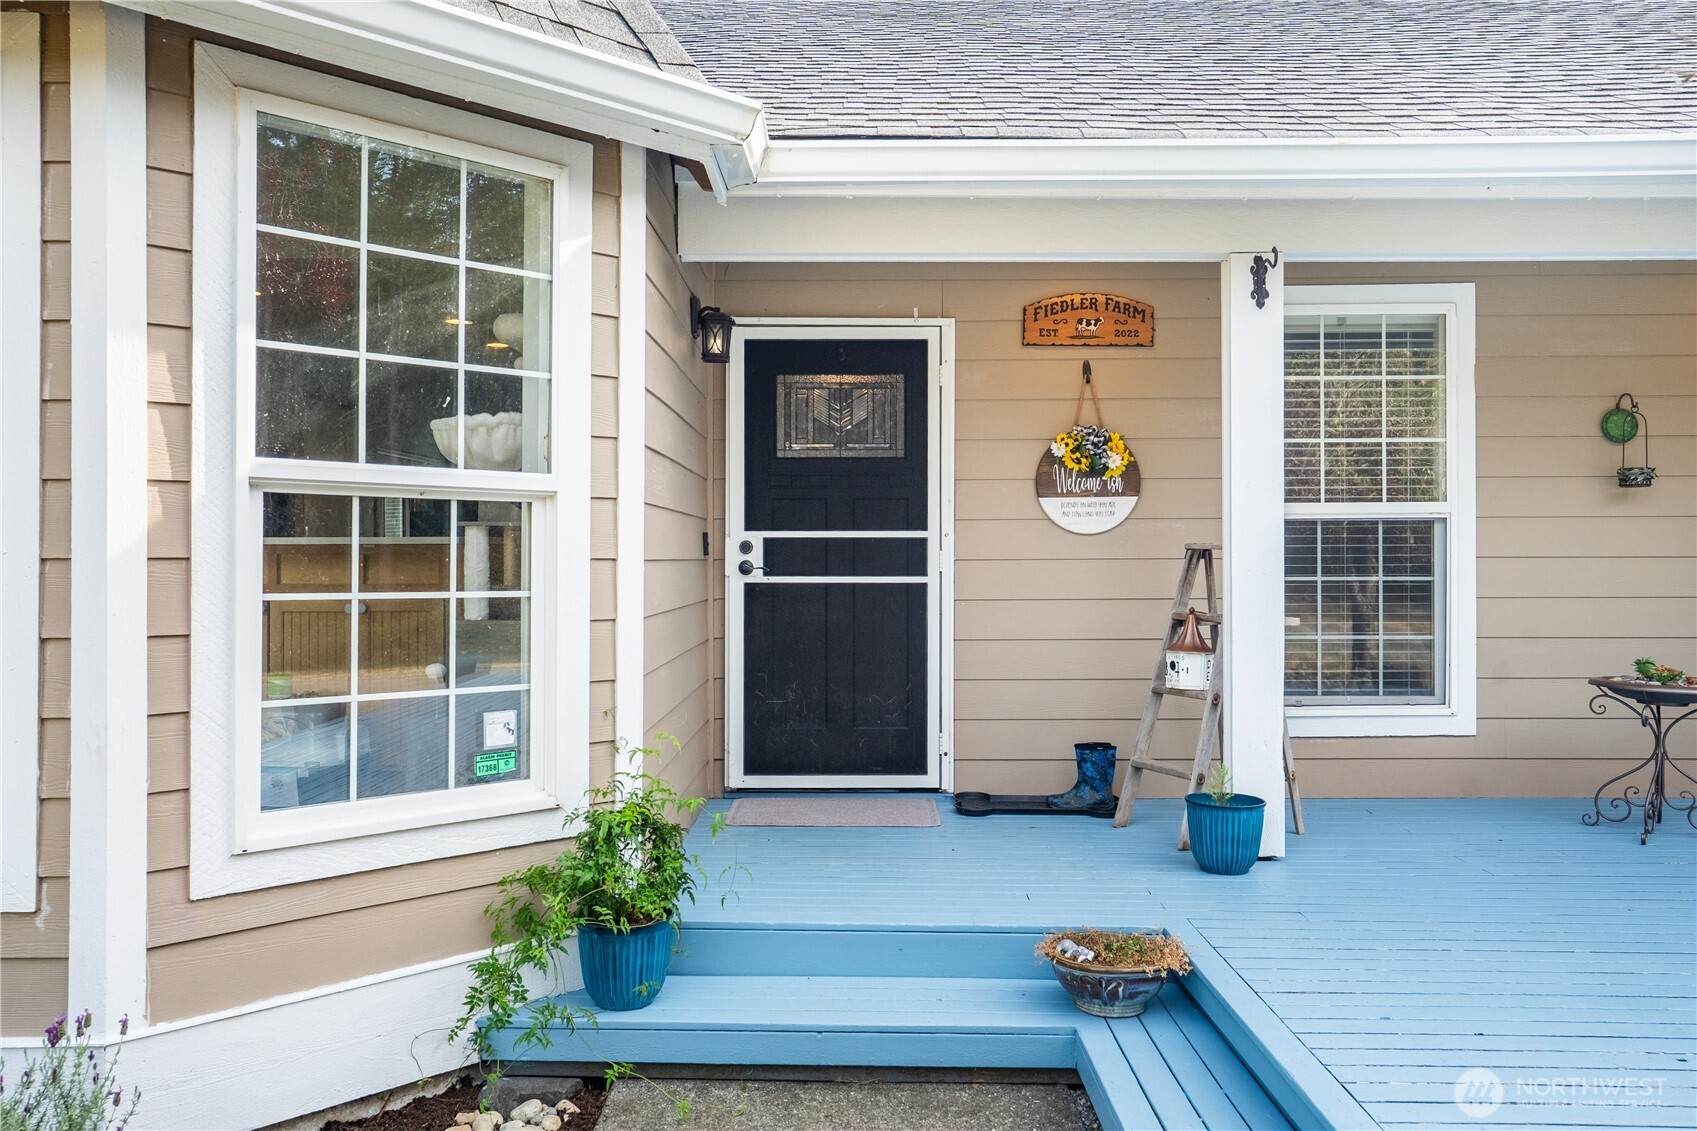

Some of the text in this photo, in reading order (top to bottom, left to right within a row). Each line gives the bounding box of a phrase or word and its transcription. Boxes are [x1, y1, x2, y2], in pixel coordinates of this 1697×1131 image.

[1033, 297, 1146, 323] FIEDLER FARM
[1114, 329, 1140, 338] 2022
[1052, 464, 1103, 494] Welcome
[478, 763, 497, 773] 17368
